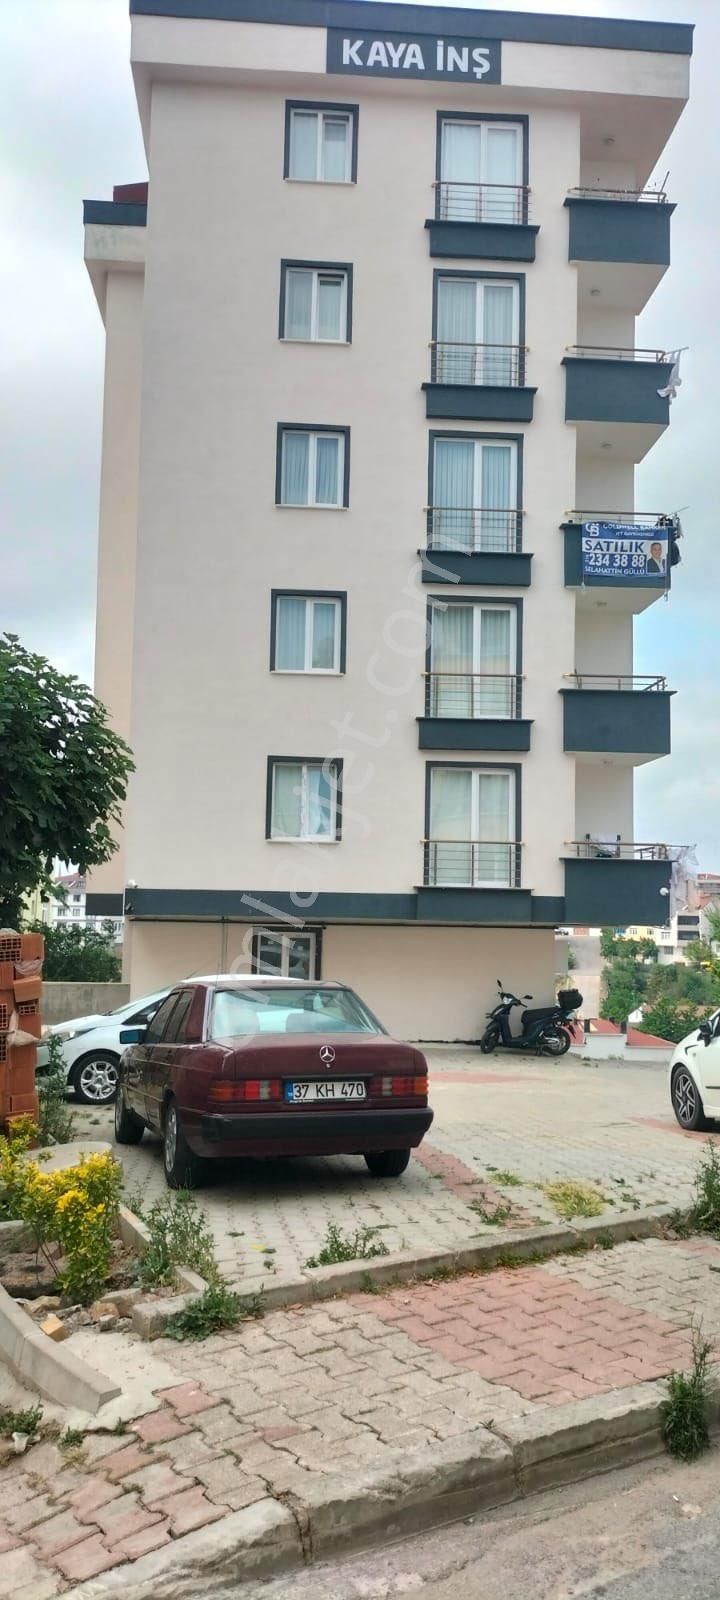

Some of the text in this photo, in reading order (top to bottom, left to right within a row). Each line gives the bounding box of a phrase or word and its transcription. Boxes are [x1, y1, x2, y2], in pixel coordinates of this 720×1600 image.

[342, 39, 491, 79] KAYA İNŞ
[585, 540, 645, 553] SATILIK
[589, 553, 610, 567] 234
[613, 554, 628, 567] 38
[631, 554, 645, 567] 88
[294, 1082, 364, 1098] 37 KH 470
